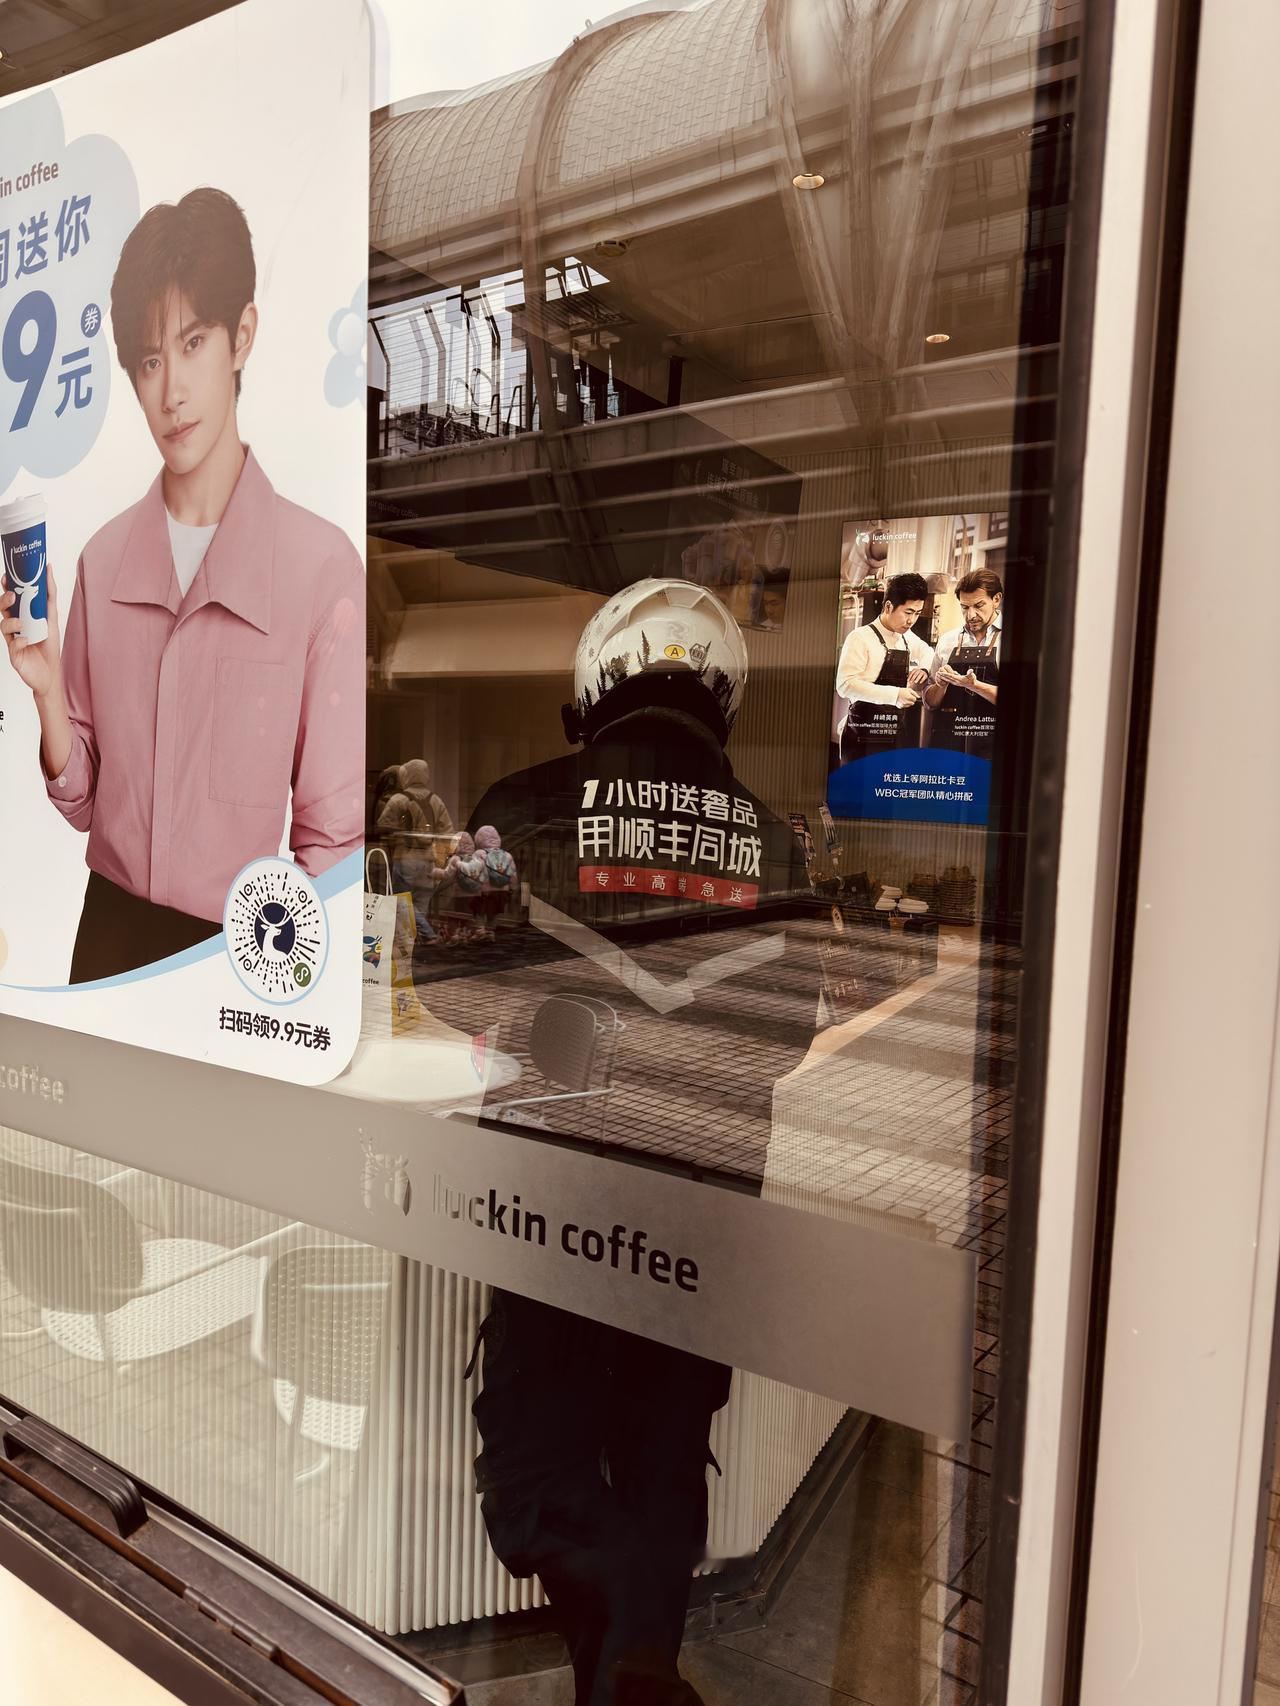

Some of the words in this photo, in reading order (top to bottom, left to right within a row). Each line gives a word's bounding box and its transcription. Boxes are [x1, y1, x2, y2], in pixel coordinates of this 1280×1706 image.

[15, 162, 59, 192] coffee
[84, 306, 98, 333] 券
[13, 544, 27, 554] luckin
[28, 540, 42, 550] coffee
[872, 533, 893, 541] luckin
[894, 532, 917, 540] coffee
[670, 647, 680, 657] A
[883, 773, 966, 786] 优选上等阿拉比卡豆
[581, 778, 758, 828] 1小时送奢品
[875, 788, 973, 801] WBC冠军团队精心拼配
[578, 815, 762, 877] 用顺丰同城
[219, 1006, 331, 1051] 扫码领9.9元券
[433, 1173, 546, 1247] luckin
[561, 1224, 699, 1293] coffee
